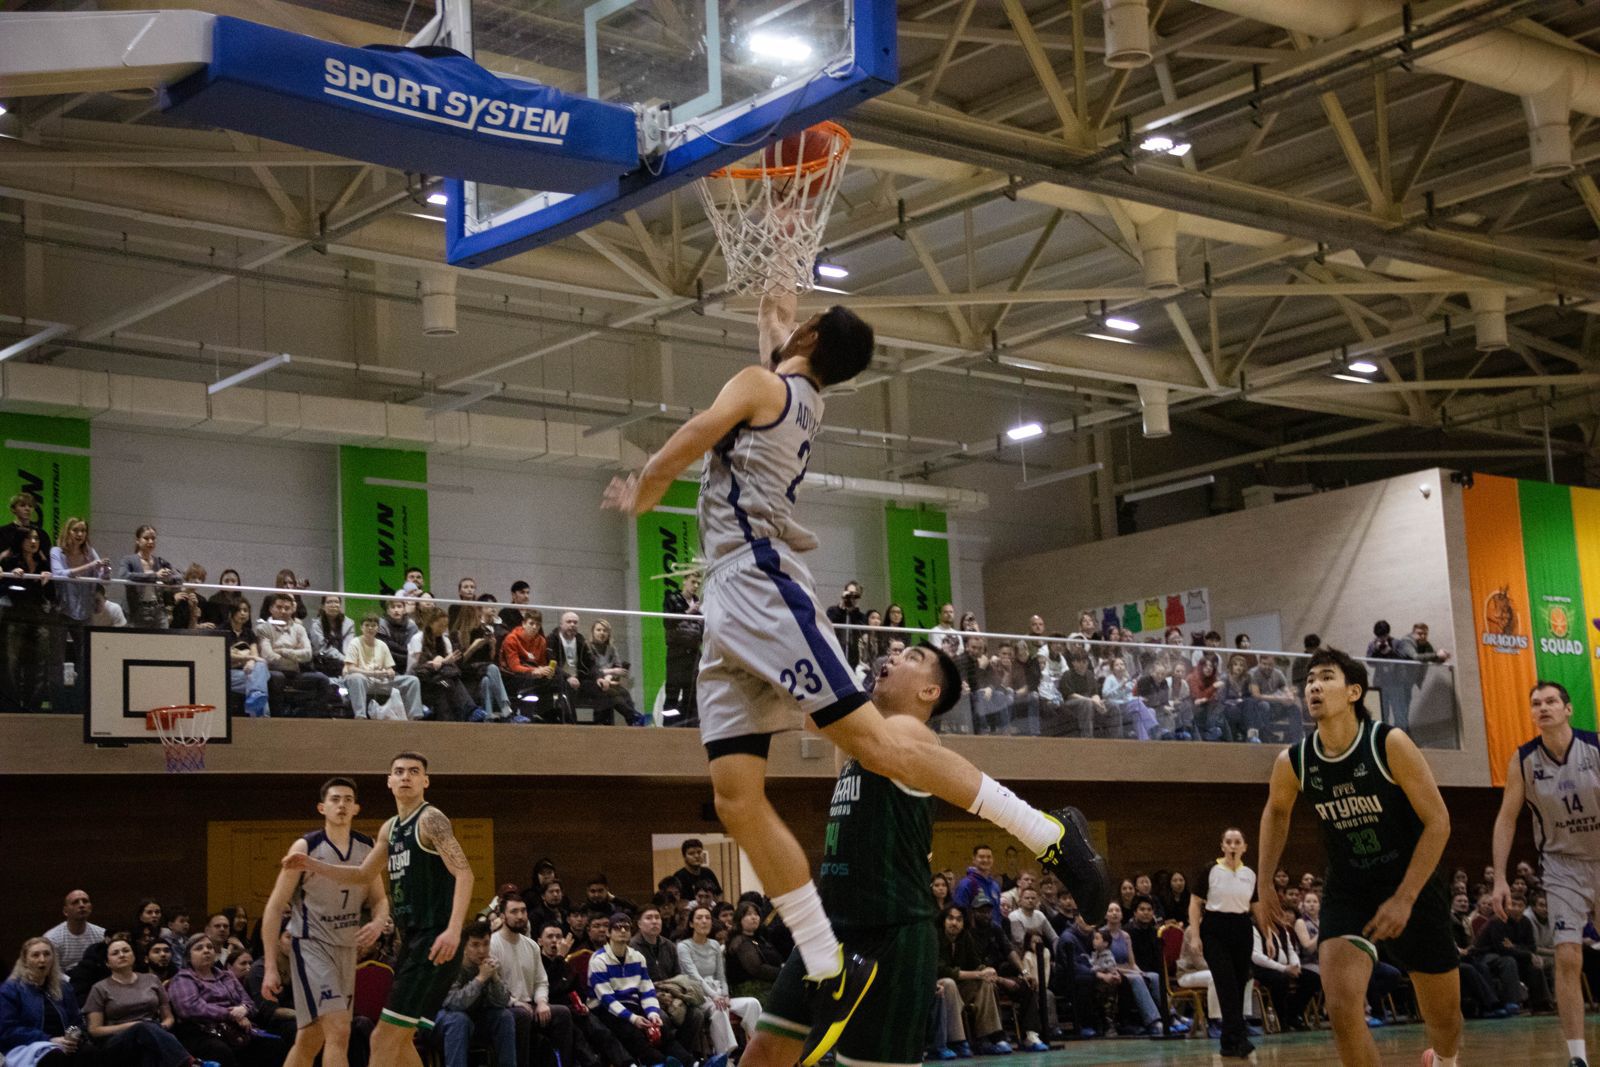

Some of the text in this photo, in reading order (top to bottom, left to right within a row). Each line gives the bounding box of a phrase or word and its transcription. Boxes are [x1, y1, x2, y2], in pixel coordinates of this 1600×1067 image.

[1540, 638, 1583, 656] SQUAD
[780, 659, 822, 701] 23
[1315, 795, 1383, 820] ATYRAU
[1561, 793, 1583, 815] 14
[1555, 816, 1597, 828] ALMATY
[1347, 828, 1381, 855] 33
[341, 889, 349, 909] 7
